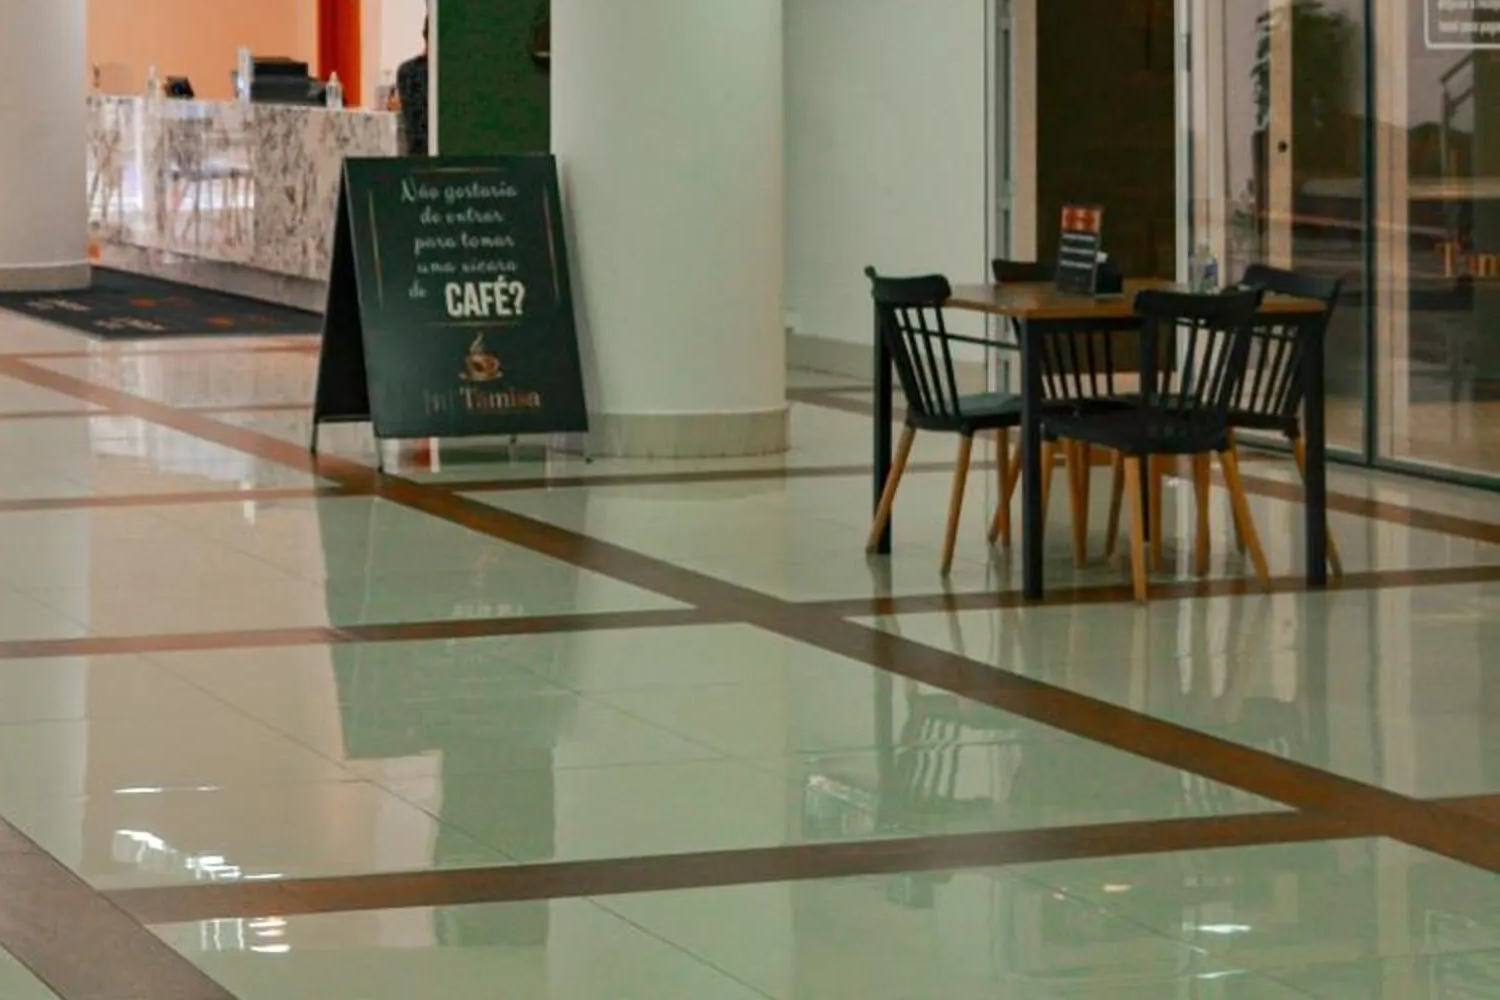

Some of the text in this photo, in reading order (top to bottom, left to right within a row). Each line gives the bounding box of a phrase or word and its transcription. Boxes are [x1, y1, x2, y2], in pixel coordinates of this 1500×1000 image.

[444, 180, 518, 204] gostaria
[419, 206, 504, 224] de entrar
[413, 231, 516, 256] para tomar
[416, 261, 456, 274] uma
[408, 275, 524, 316] de CAFÉ?
